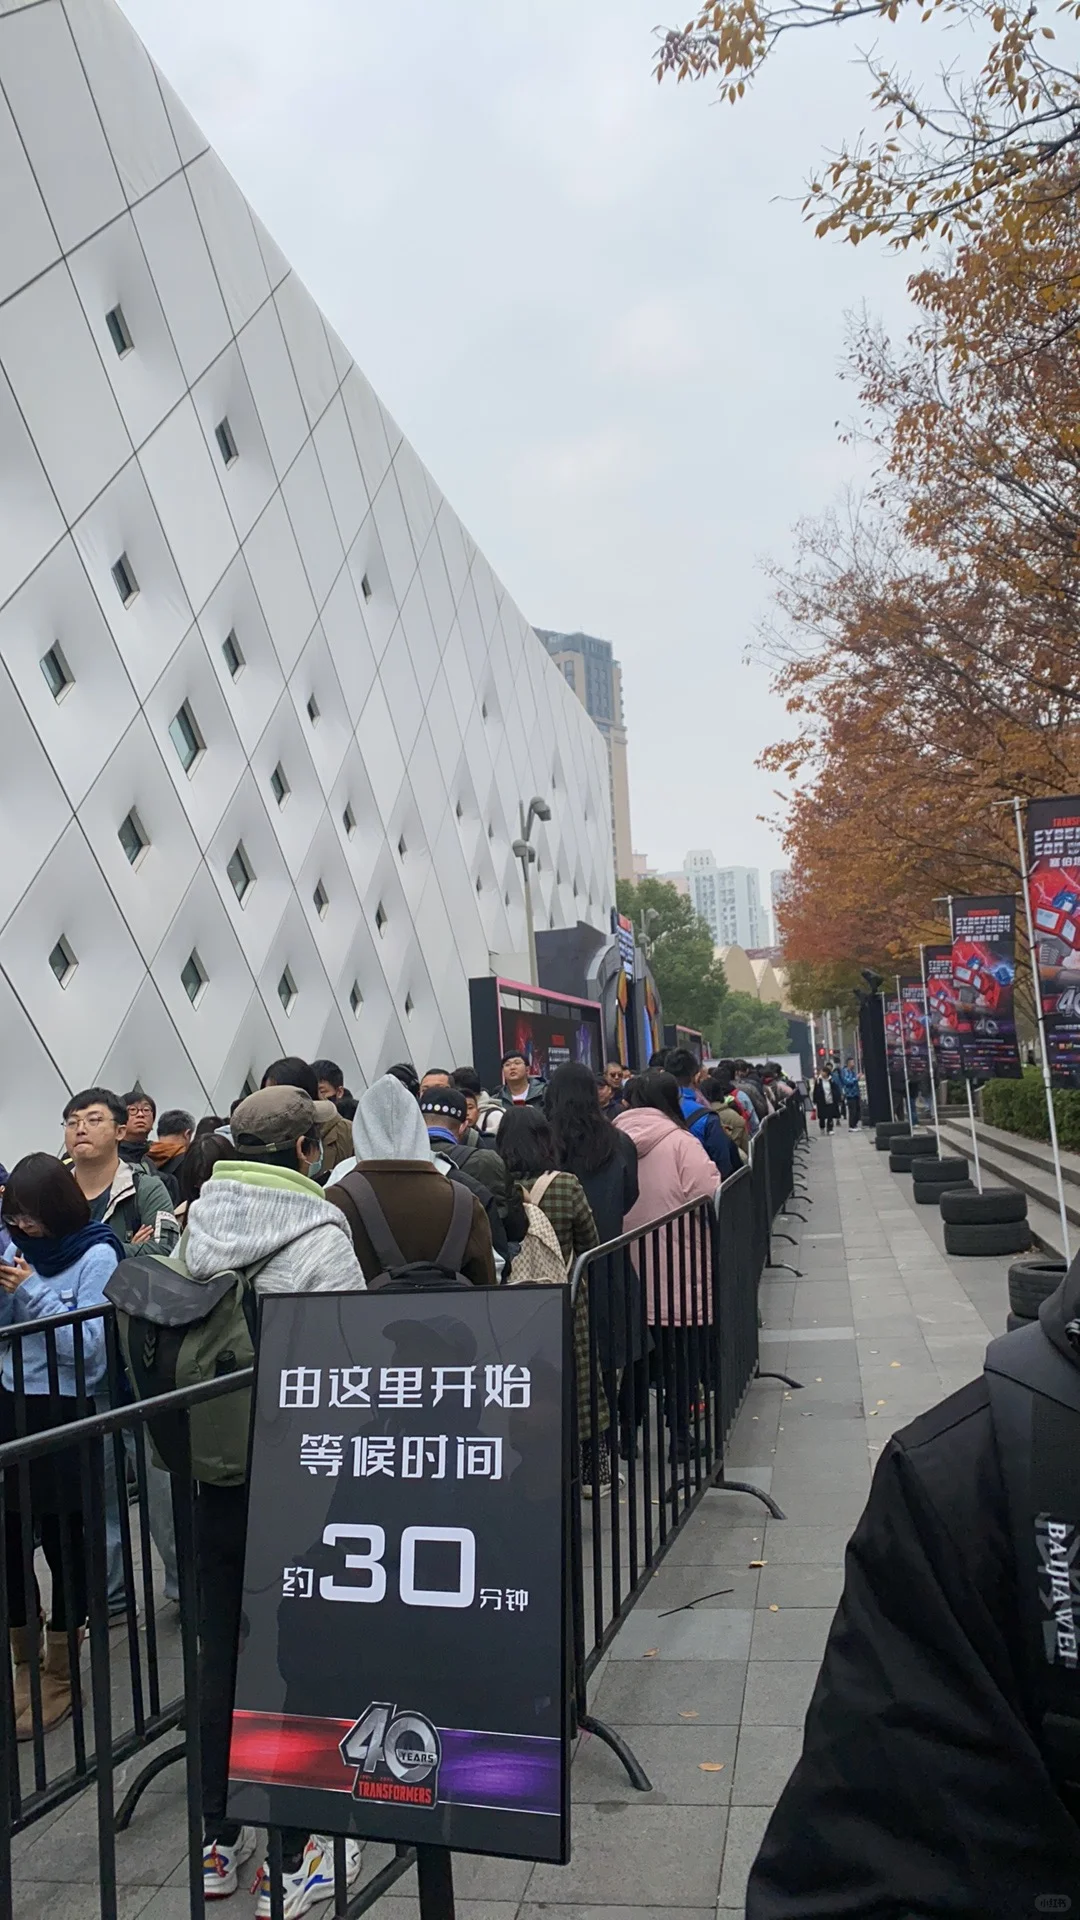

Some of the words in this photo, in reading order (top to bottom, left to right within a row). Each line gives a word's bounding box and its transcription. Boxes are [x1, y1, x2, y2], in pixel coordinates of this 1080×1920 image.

[279, 1364, 531, 1408] 由这里开始
[300, 1434, 503, 1480] 等候时间
[1046, 1521, 1078, 1660] BAIJIAWEI
[343, 1704, 439, 1783] 40
[401, 1752, 434, 1764] YEARS
[358, 1781, 432, 1804] TRANSFORMERS
